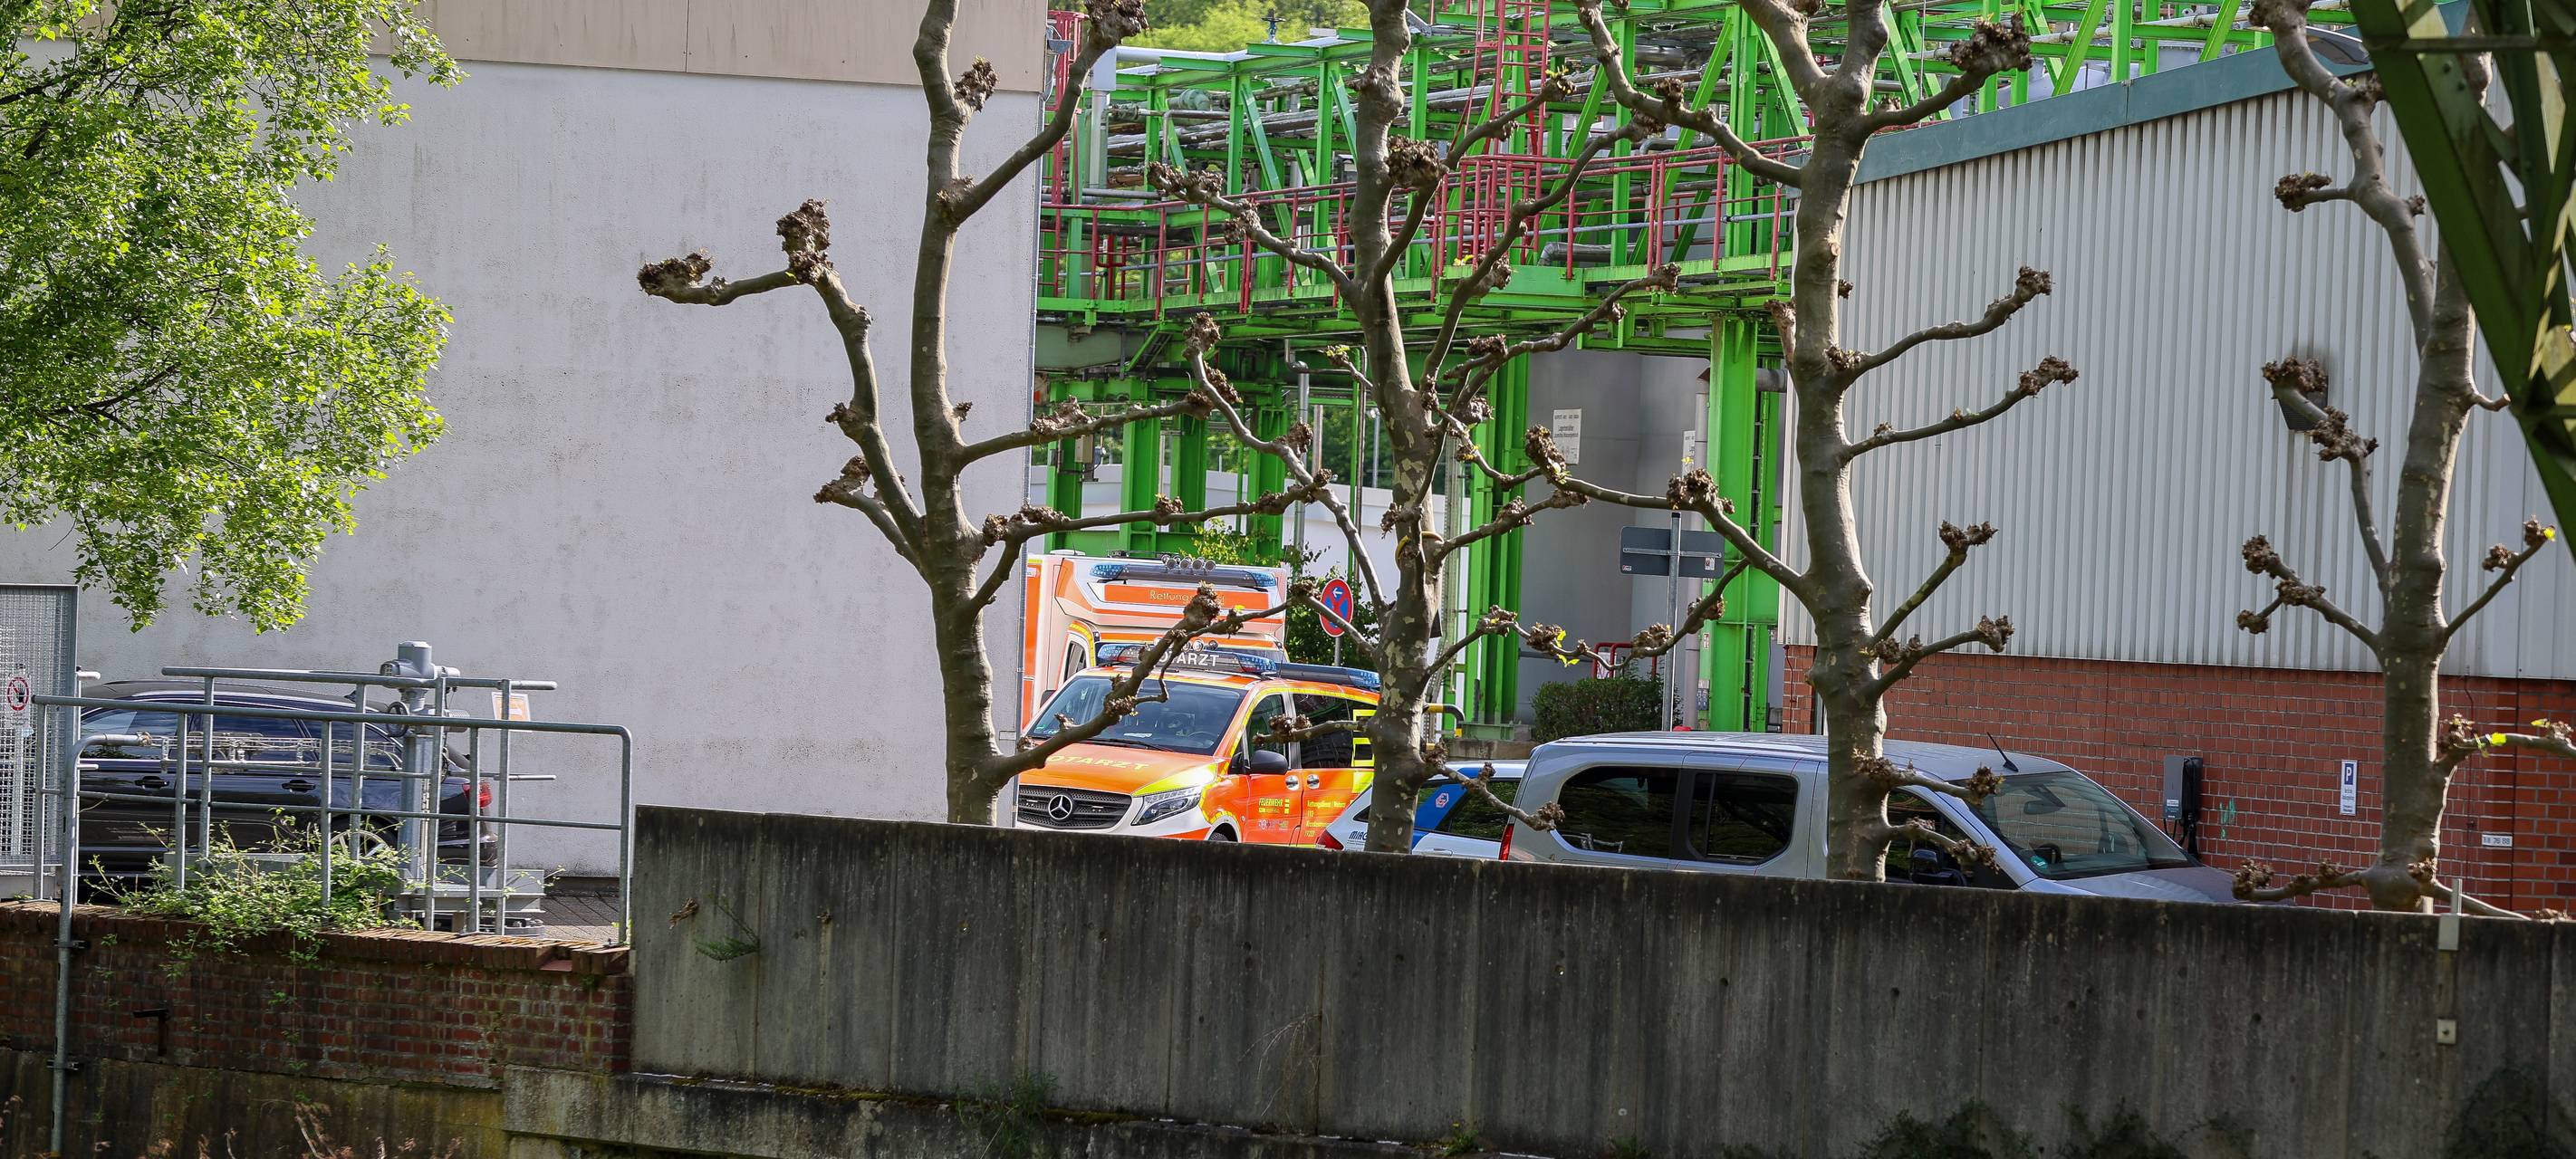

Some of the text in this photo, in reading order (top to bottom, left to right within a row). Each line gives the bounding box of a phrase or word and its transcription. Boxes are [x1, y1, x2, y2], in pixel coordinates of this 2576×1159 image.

[1159, 651, 1220, 667] OARZT
[1046, 755, 1149, 771] OTARZT
[2346, 766, 2352, 782] P
[1259, 798, 1283, 808] FEUERWEHR
